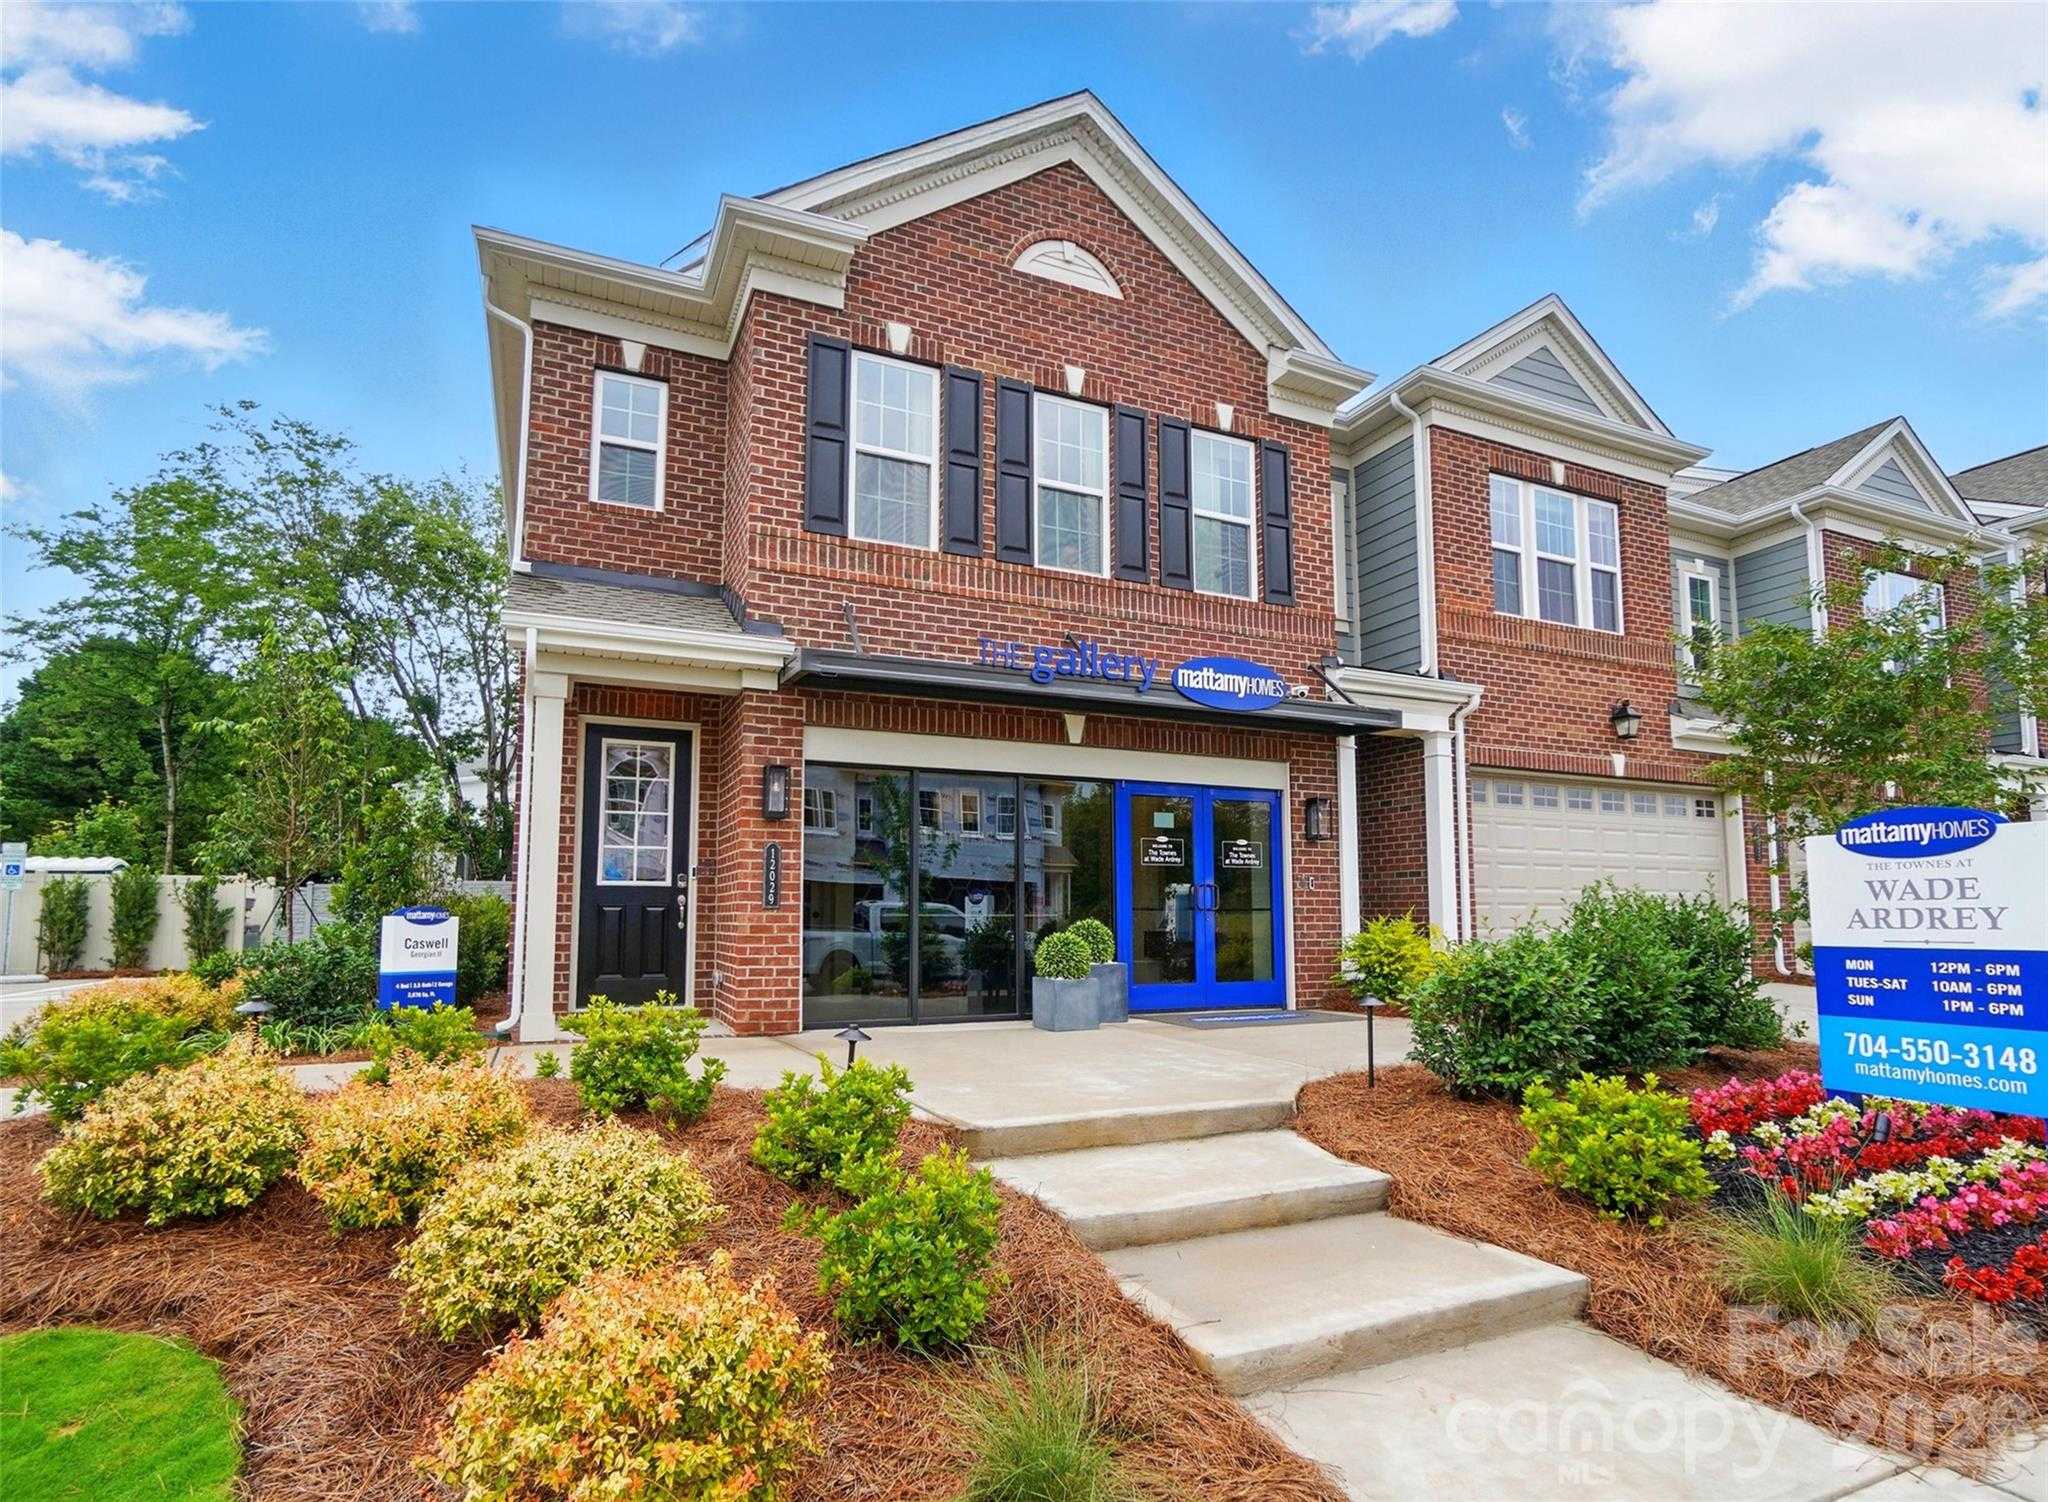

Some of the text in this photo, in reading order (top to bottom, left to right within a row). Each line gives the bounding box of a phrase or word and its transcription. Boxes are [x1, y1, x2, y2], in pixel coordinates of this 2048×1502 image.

[977, 637, 1158, 693] THE gallery
[1178, 668, 1285, 698] mattamyHOMES
[1841, 818, 1990, 845] mattamyHOMES
[1866, 858, 1975, 871] THE TOWNES AT
[768, 848, 776, 905] 12029
[1864, 877, 1982, 901] WADE
[1846, 906, 2009, 930] ARDREY
[405, 937, 448, 950] Caswell
[1845, 959, 1874, 971] MON
[1930, 962, 1971, 975] 12PM
[1985, 964, 2020, 977] 6PM
[1846, 976, 1908, 990] TUES-SAT
[1931, 981, 1972, 994] 10AM
[1987, 983, 2022, 997] 6PM
[1848, 994, 1874, 1006] SUN
[1943, 1000, 1974, 1013] 1PM
[1988, 1003, 2024, 1017] 6PM
[1844, 1032, 2037, 1075] 704-550-3148
[1855, 1062, 2028, 1095] mattamyhomes.com
